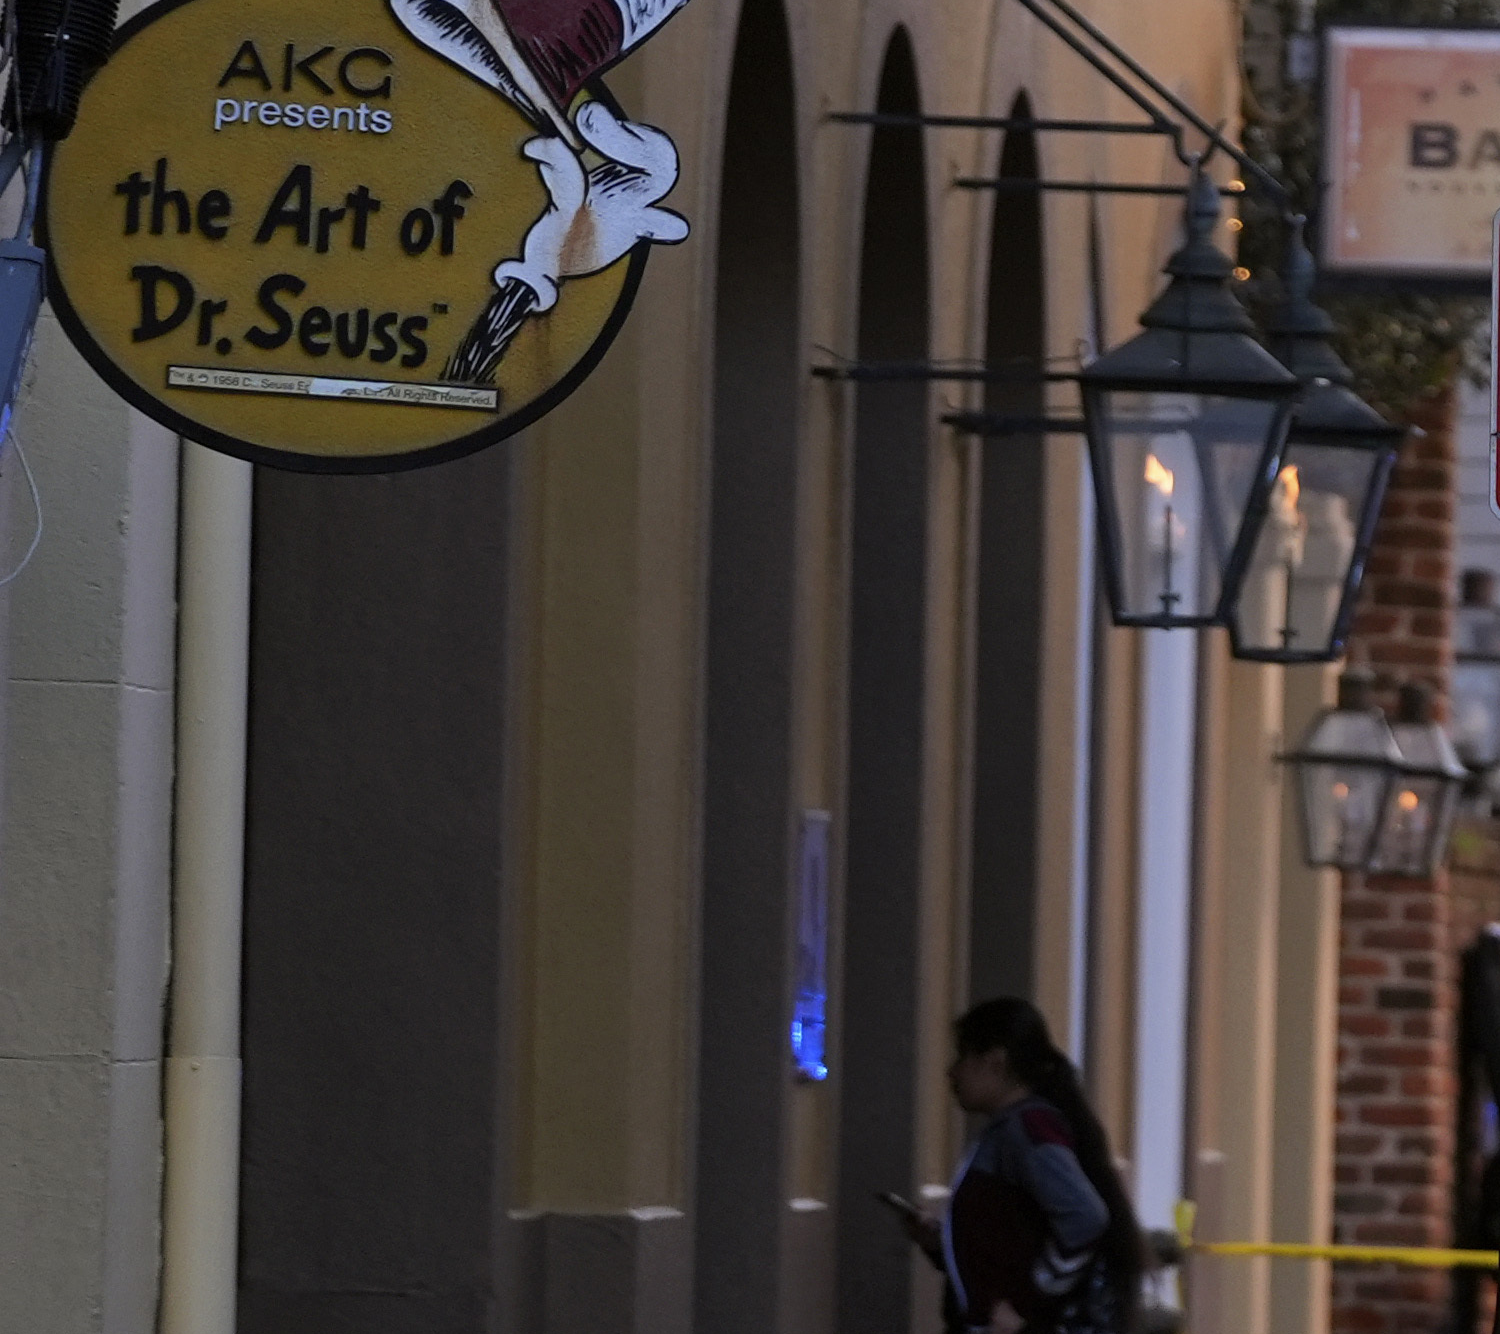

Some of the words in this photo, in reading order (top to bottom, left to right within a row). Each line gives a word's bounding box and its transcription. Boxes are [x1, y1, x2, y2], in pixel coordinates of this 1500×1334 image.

[214, 98, 394, 134] presents
[115, 157, 233, 241] the
[254, 163, 382, 254] Art
[399, 179, 475, 257] of
[131, 265, 234, 356] Dr.
